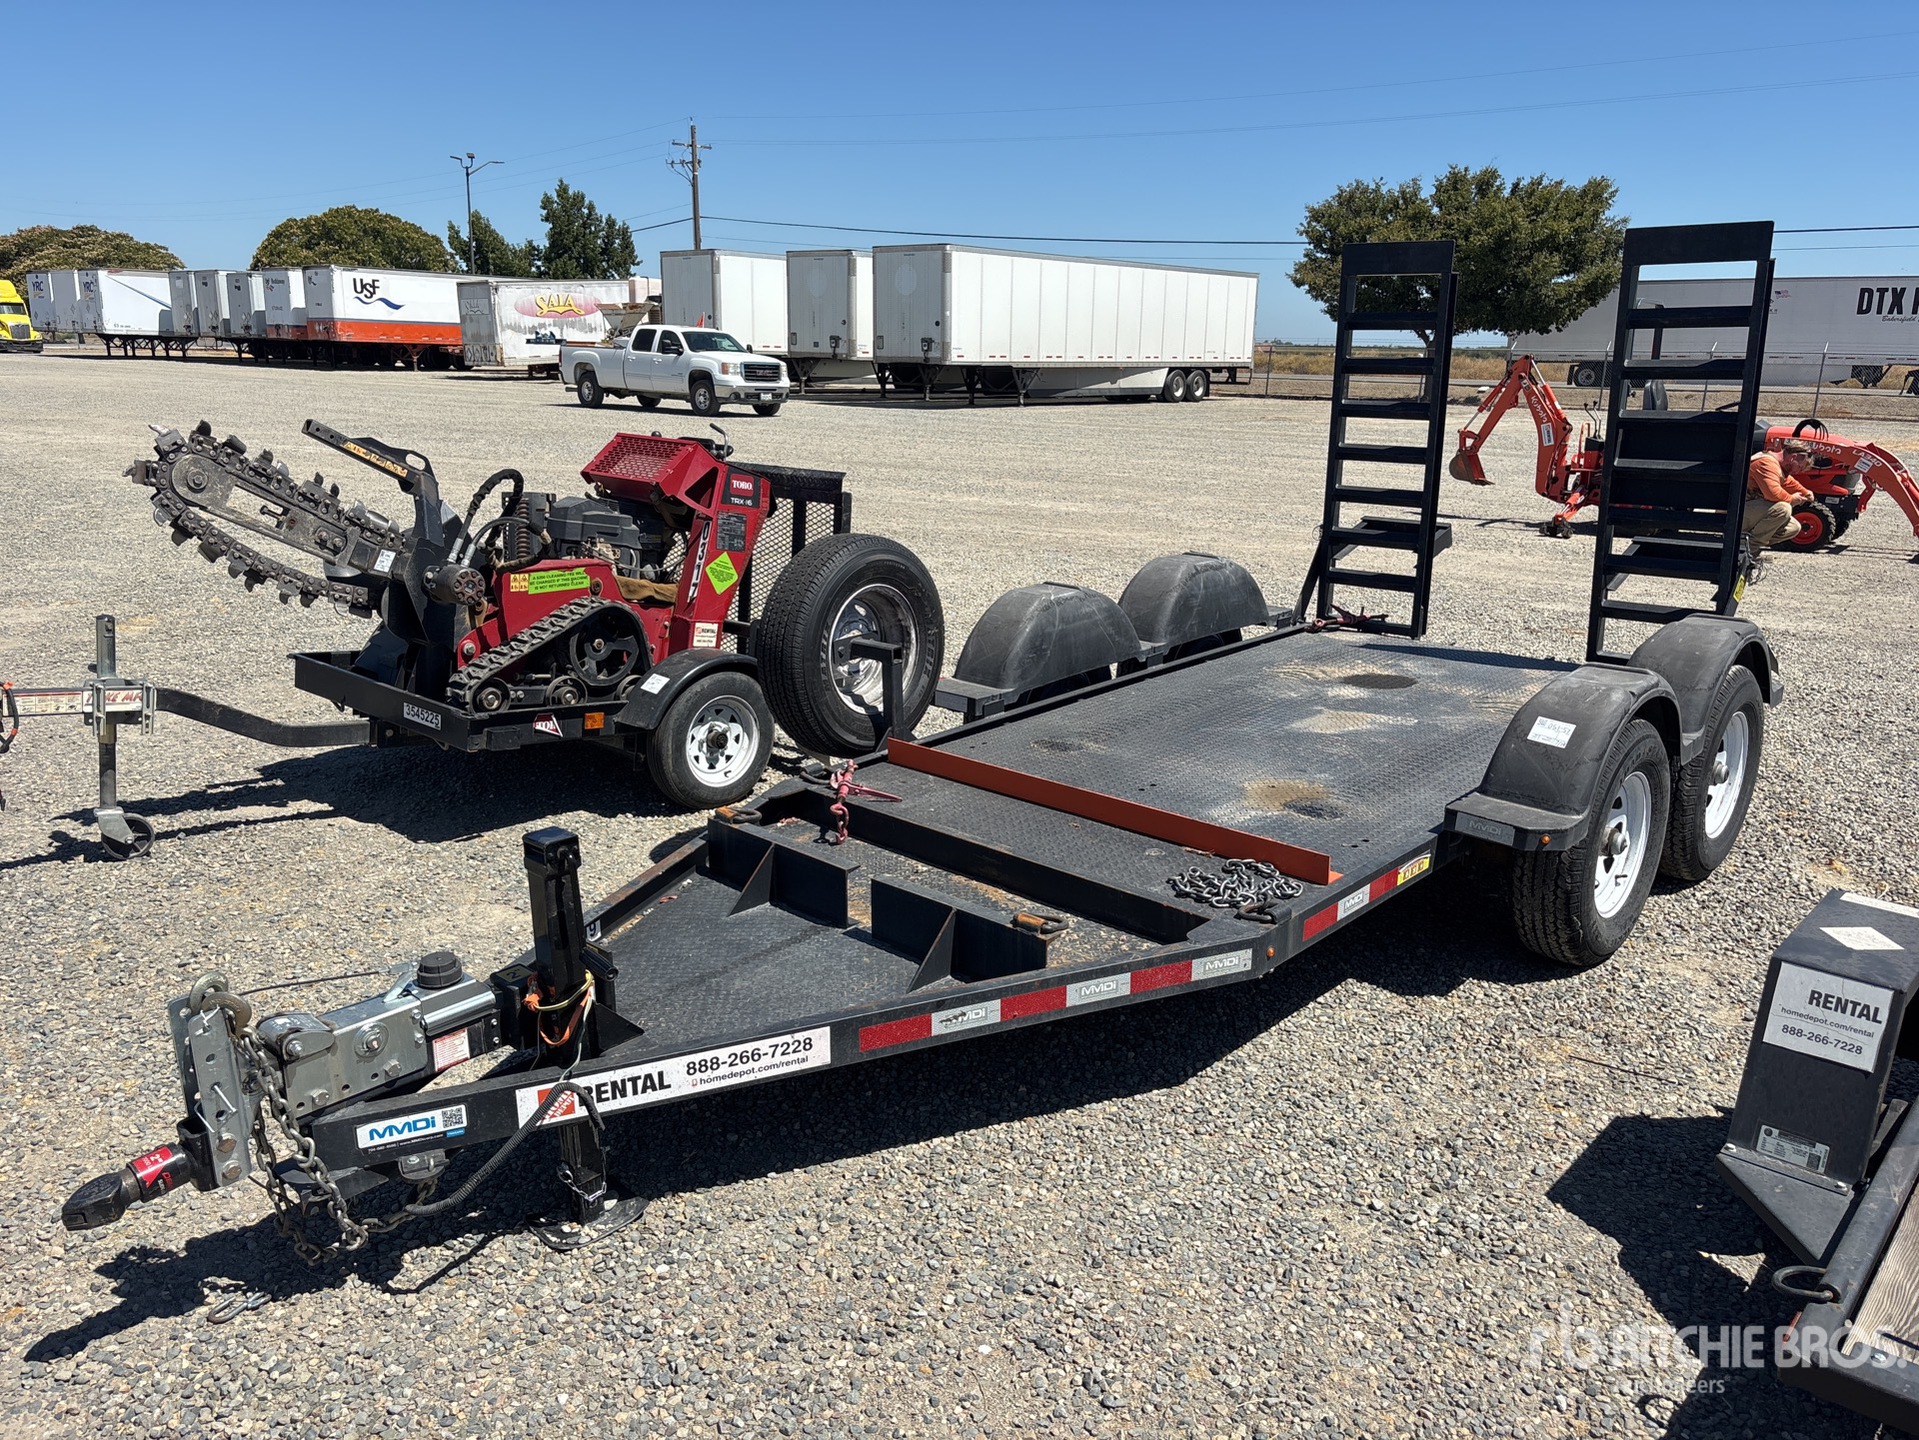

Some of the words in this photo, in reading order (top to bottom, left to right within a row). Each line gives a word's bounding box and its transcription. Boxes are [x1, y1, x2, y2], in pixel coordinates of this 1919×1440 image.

[32, 281, 44, 292] YRC
[83, 281, 94, 292] YRC
[353, 278, 380, 299] USF
[1856, 287, 1907, 315] DTX
[1531, 395, 1548, 423] Kubota
[731, 479, 754, 491] TORO
[405, 703, 441, 728] 3545225
[1807, 989, 1883, 1025] RENTAL
[1780, 1006, 1875, 1039] homedepot.com/rental
[1781, 1024, 1863, 1055] 888-266-7228
[686, 1036, 814, 1076] 888-266-7228
[699, 1055, 809, 1086] homedepot.com/rental
